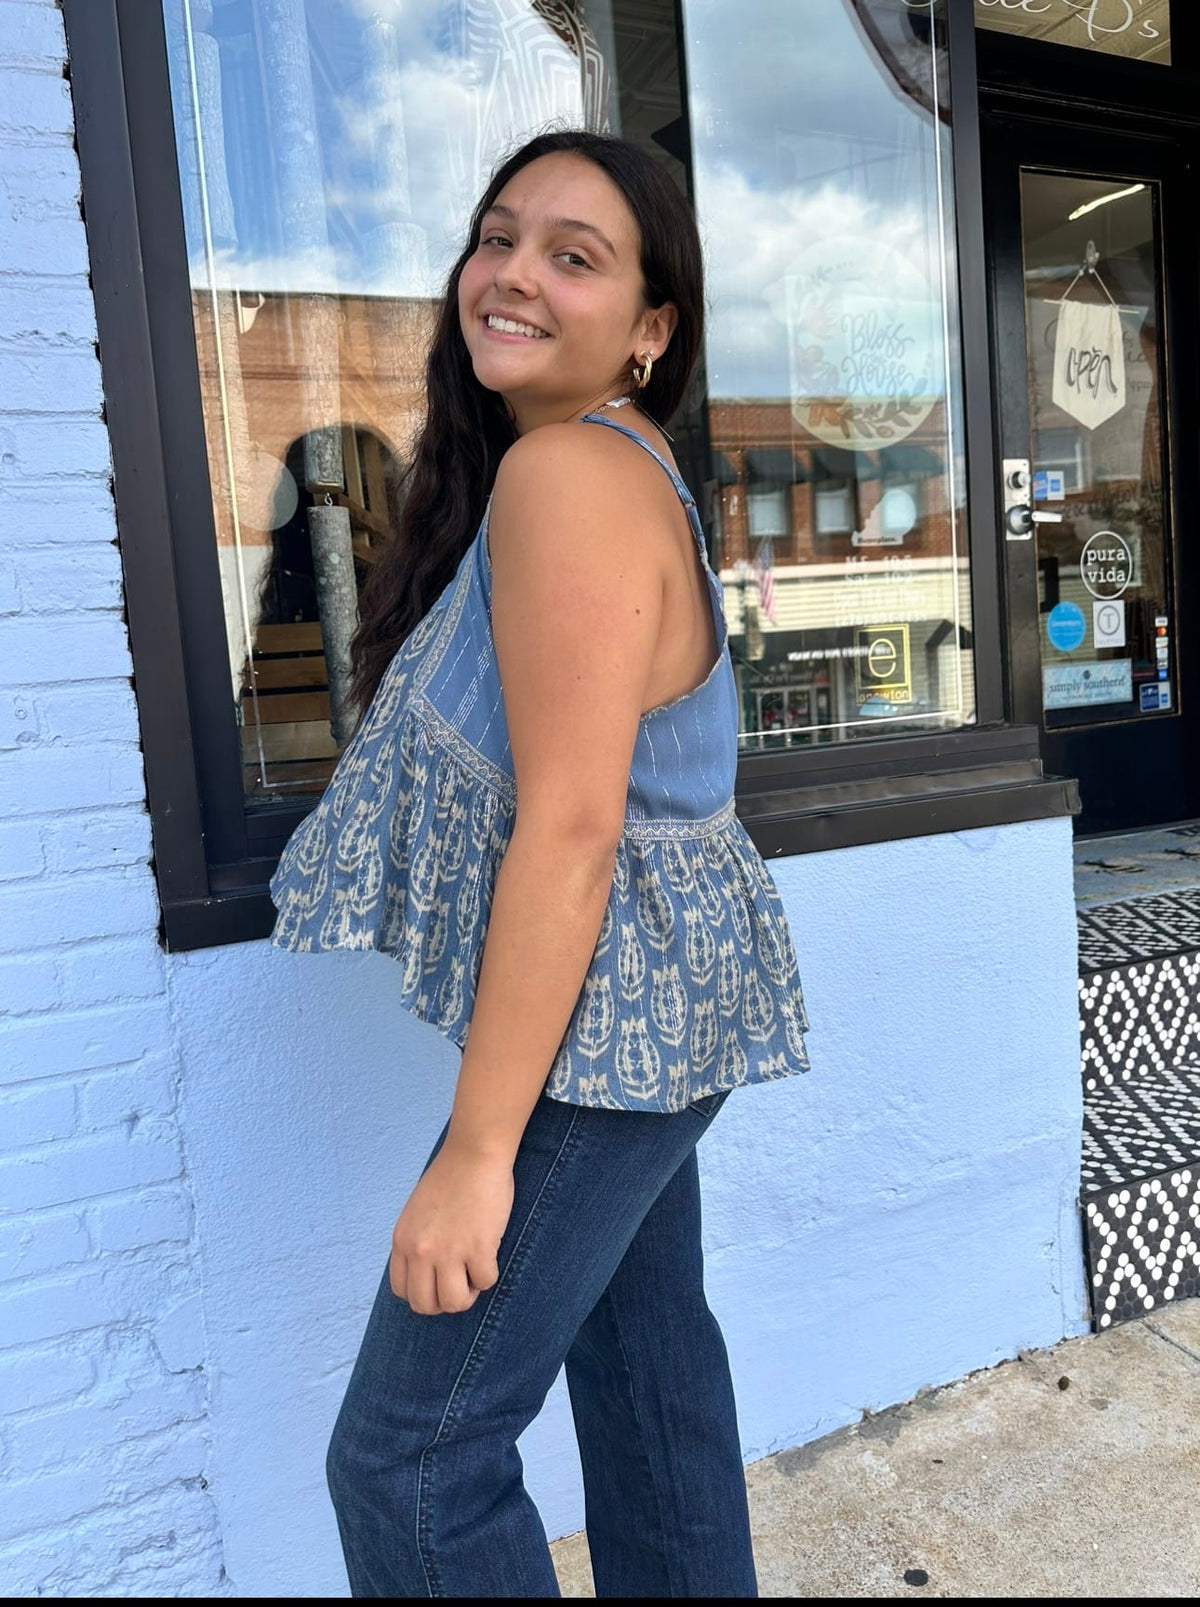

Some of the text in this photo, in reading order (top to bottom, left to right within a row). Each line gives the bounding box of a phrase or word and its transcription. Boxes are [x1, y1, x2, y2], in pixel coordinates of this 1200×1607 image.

[1086, 548, 1126, 566] pura
[1087, 566, 1126, 583] vida
[868, 638, 897, 678] e
[1049, 674, 1126, 694] simply southern
